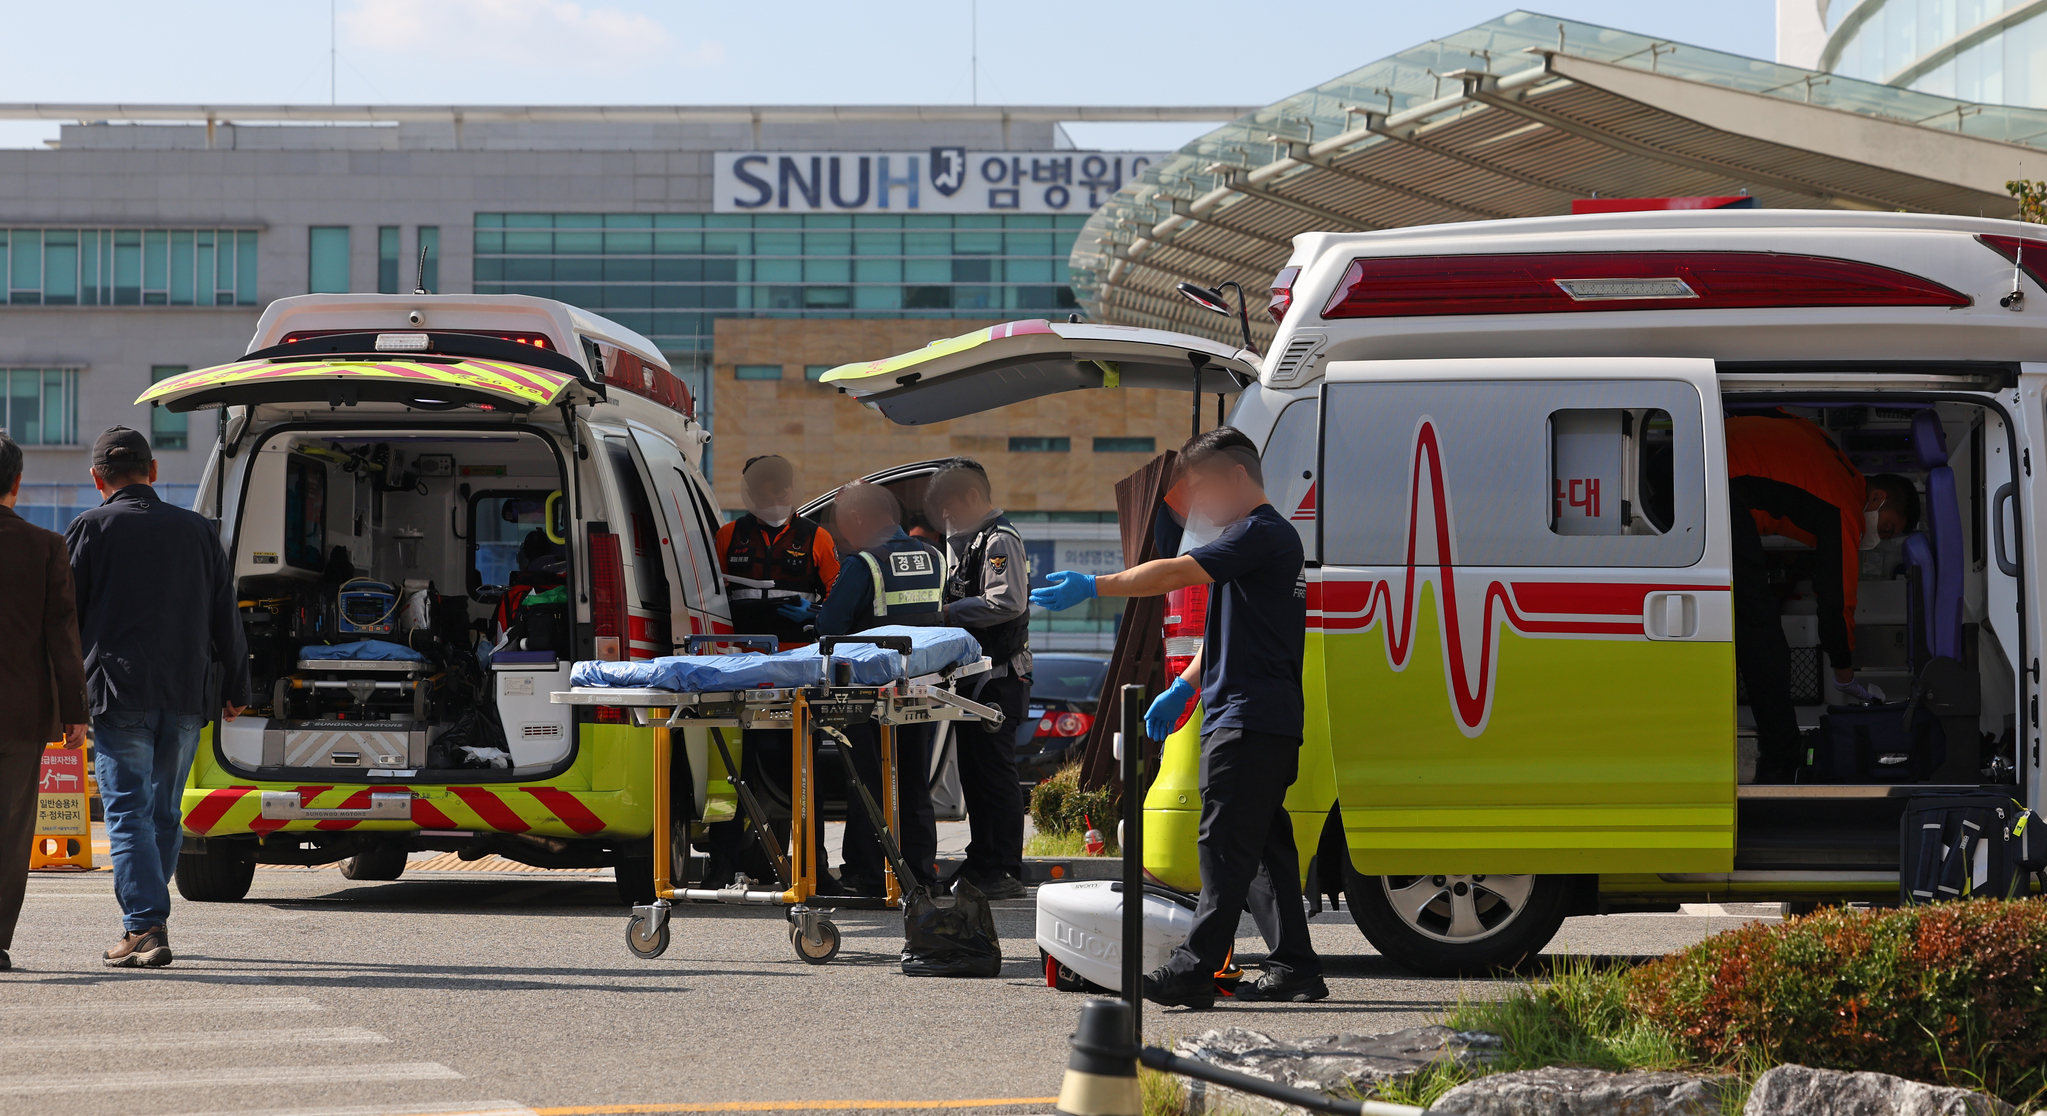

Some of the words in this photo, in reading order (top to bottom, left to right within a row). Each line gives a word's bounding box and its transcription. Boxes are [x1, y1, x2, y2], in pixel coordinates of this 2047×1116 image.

[732, 155, 919, 209] SNUH
[981, 155, 1150, 209] 암병원
[1557, 478, 1600, 518] 대
[897, 555, 926, 571] 경찰
[898, 589, 934, 602] POLICE
[40, 799, 79, 809] 일반승용차
